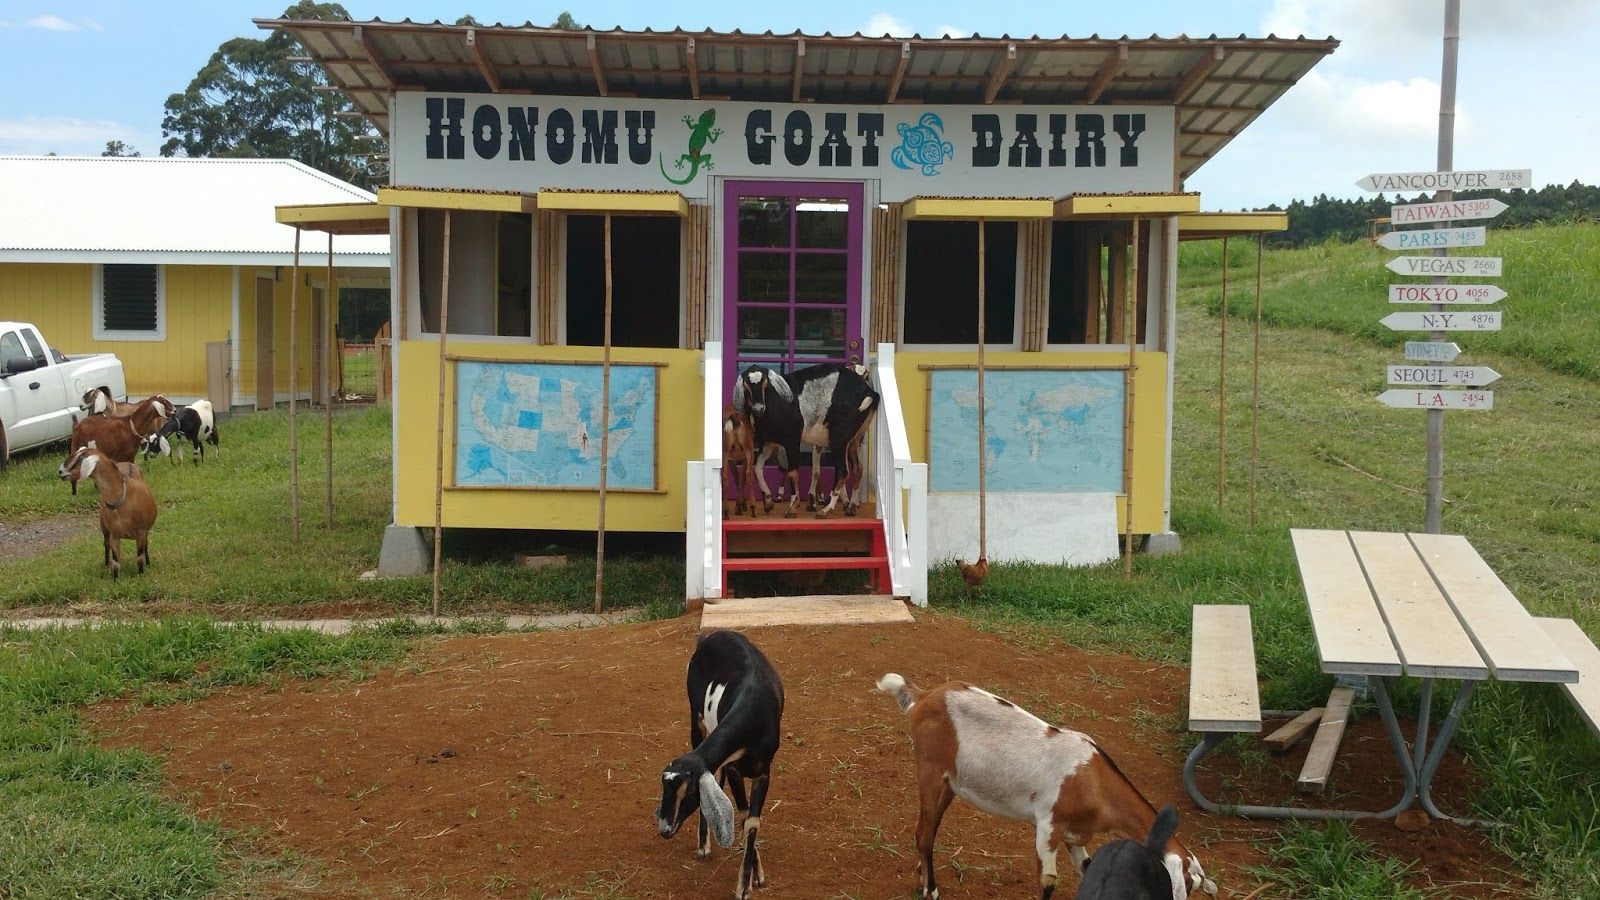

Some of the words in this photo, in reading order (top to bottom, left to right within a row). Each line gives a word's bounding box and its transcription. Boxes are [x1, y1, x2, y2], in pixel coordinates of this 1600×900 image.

[426, 97, 656, 165] HONOMU
[744, 109, 884, 166] GOAT
[971, 113, 1147, 168] DAIRY
[1370, 173, 1489, 190] VANCOUVER
[1499, 172, 1523, 181] 2688
[1394, 203, 1466, 221] TAIWAN
[1467, 202, 1490, 211] 5305
[1399, 232, 1448, 247] PARIS
[1407, 259, 1466, 274] VEGAS
[1473, 260, 1496, 270] 2660
[1395, 287, 1458, 302] TOKYO
[1465, 288, 1489, 297] 4056
[1422, 314, 1457, 328] N.Y.
[1471, 314, 1494, 323] 4876
[1394, 369, 1448, 383] SEOUL
[1453, 370, 1474, 379] 4743
[1416, 392, 1448, 406] L.A.
[1462, 393, 1484, 403] 2454
